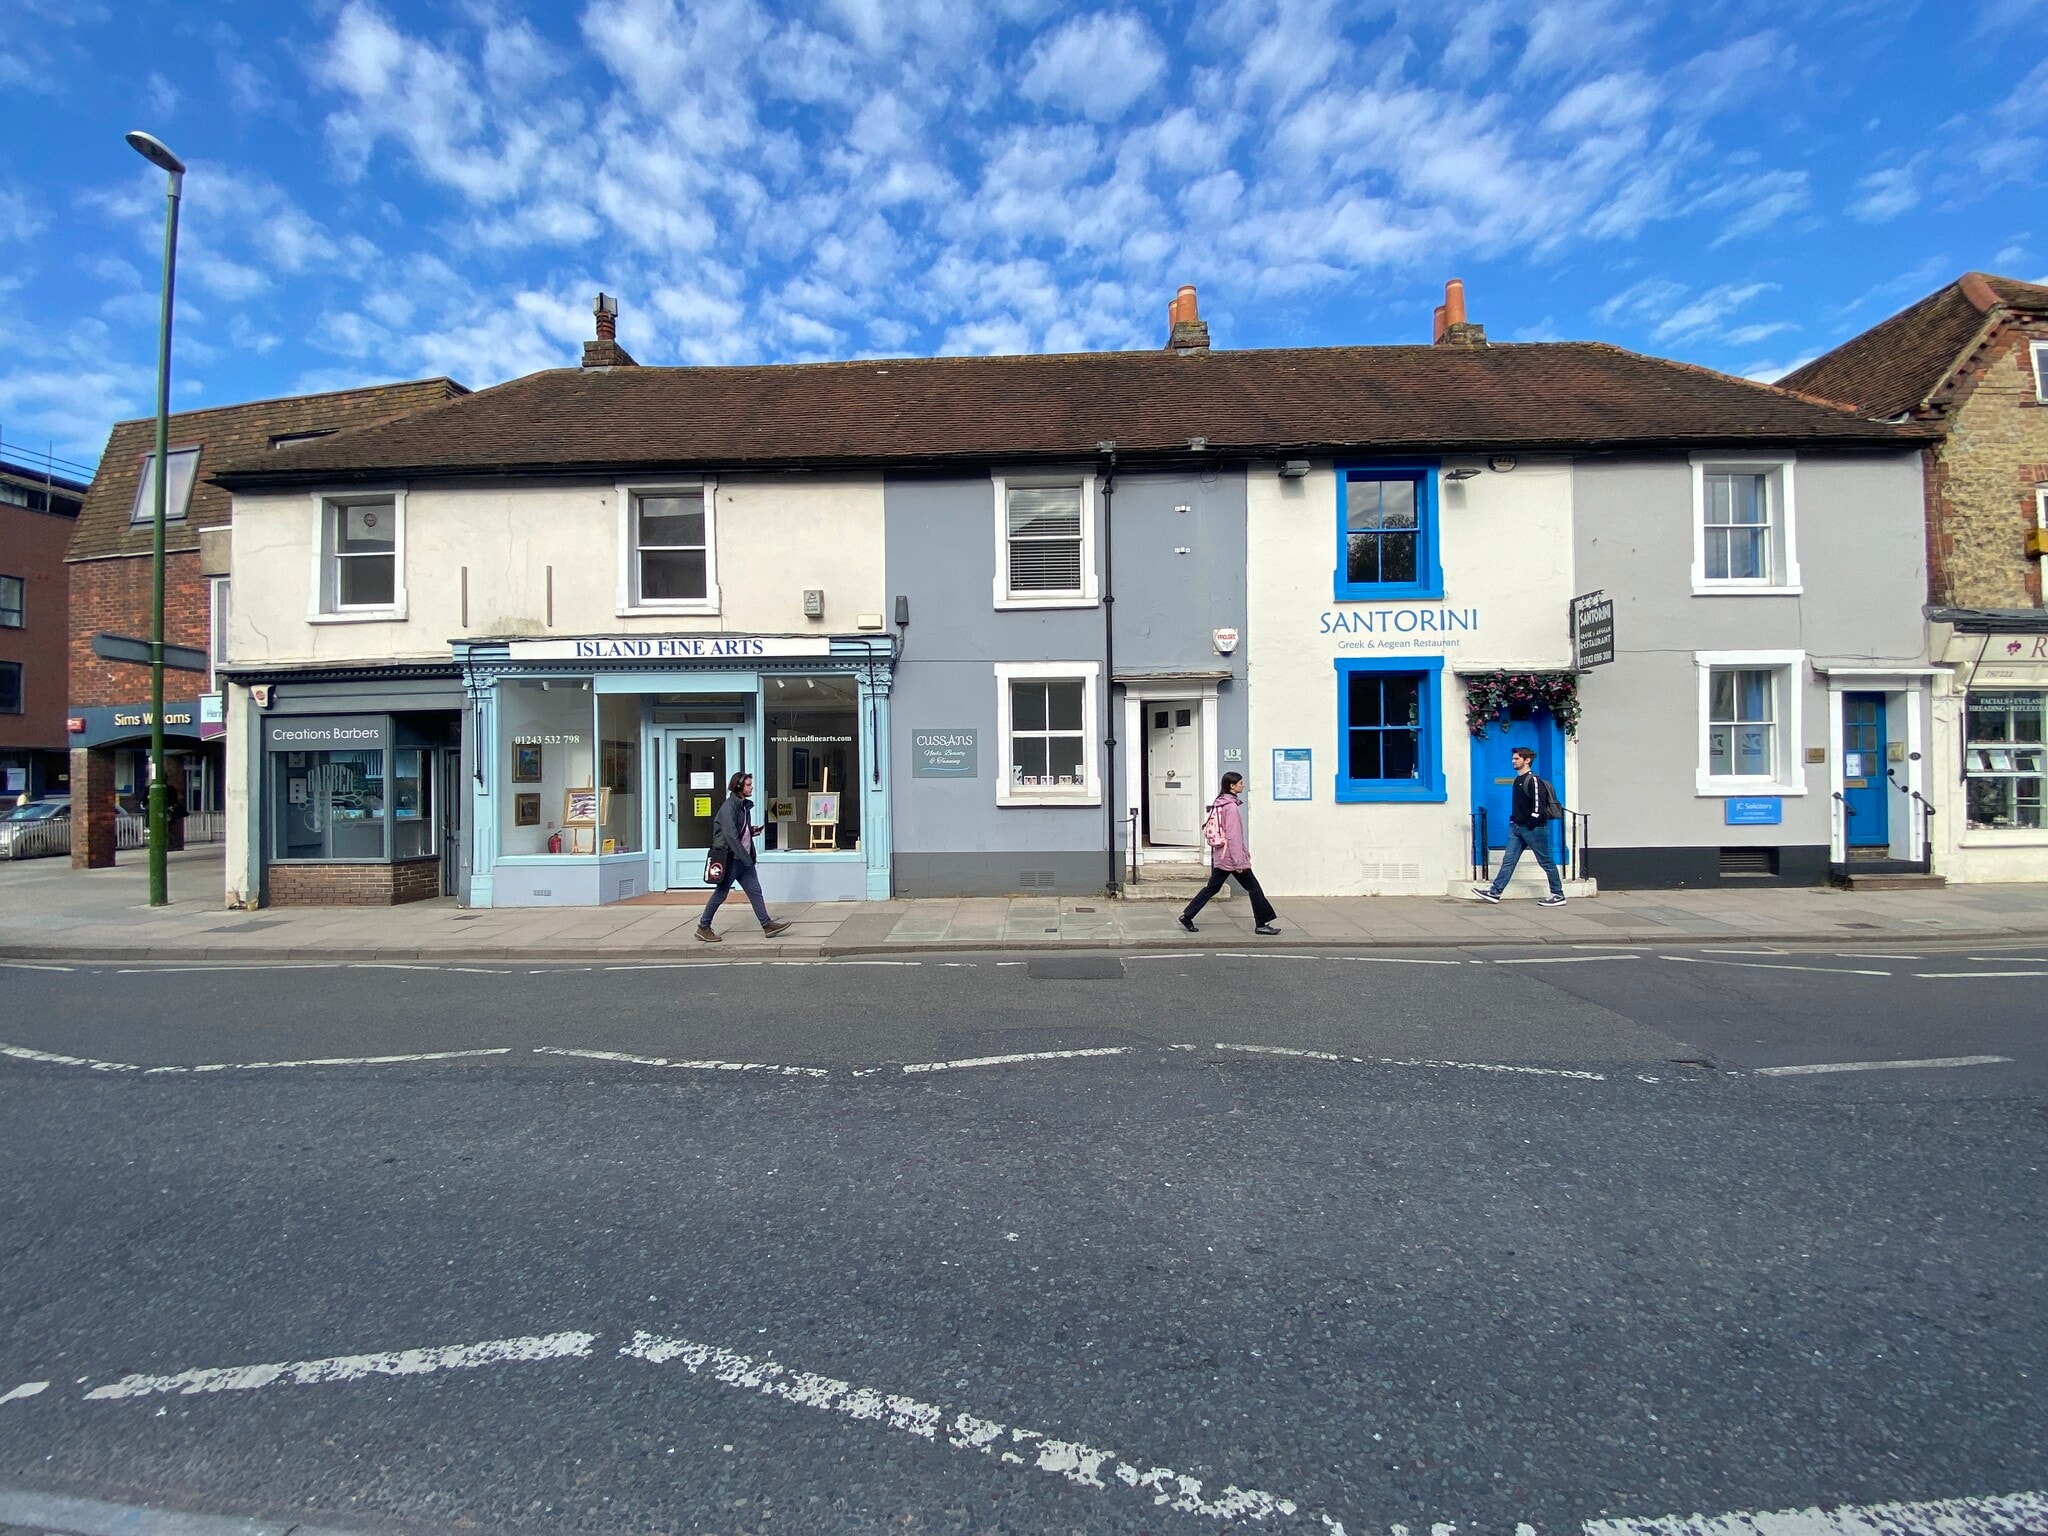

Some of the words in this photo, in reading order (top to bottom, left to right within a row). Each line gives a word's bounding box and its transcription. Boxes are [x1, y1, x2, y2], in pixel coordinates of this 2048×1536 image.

[1320, 608, 1478, 634] SANTORINI
[1580, 604, 1611, 627] SANTORINI
[575, 640, 651, 657] ISLAND
[658, 639, 706, 656] FINE
[710, 639, 764, 655] ARTS
[1338, 640, 1365, 649] Greek
[1367, 640, 1375, 648] &
[1377, 639, 1411, 650] Aegean
[1413, 637, 1460, 647] Restaurant
[1580, 635, 1611, 650] RESTAURANT
[115, 712, 141, 726] Sims
[142, 712, 191, 726] Wams
[272, 728, 331, 740] Creations
[333, 727, 380, 739] Barbers
[515, 735, 542, 745] 01243
[544, 735, 561, 744] 532
[563, 734, 580, 744] 798
[770, 734, 852, 742] www.islandfinearts.com
[916, 735, 973, 747] CUSSANS
[1228, 749, 1237, 757] 13
[307, 764, 354, 793] BARBER
[1736, 802, 1744, 811] JC
[1744, 802, 1773, 810] Solicitors
